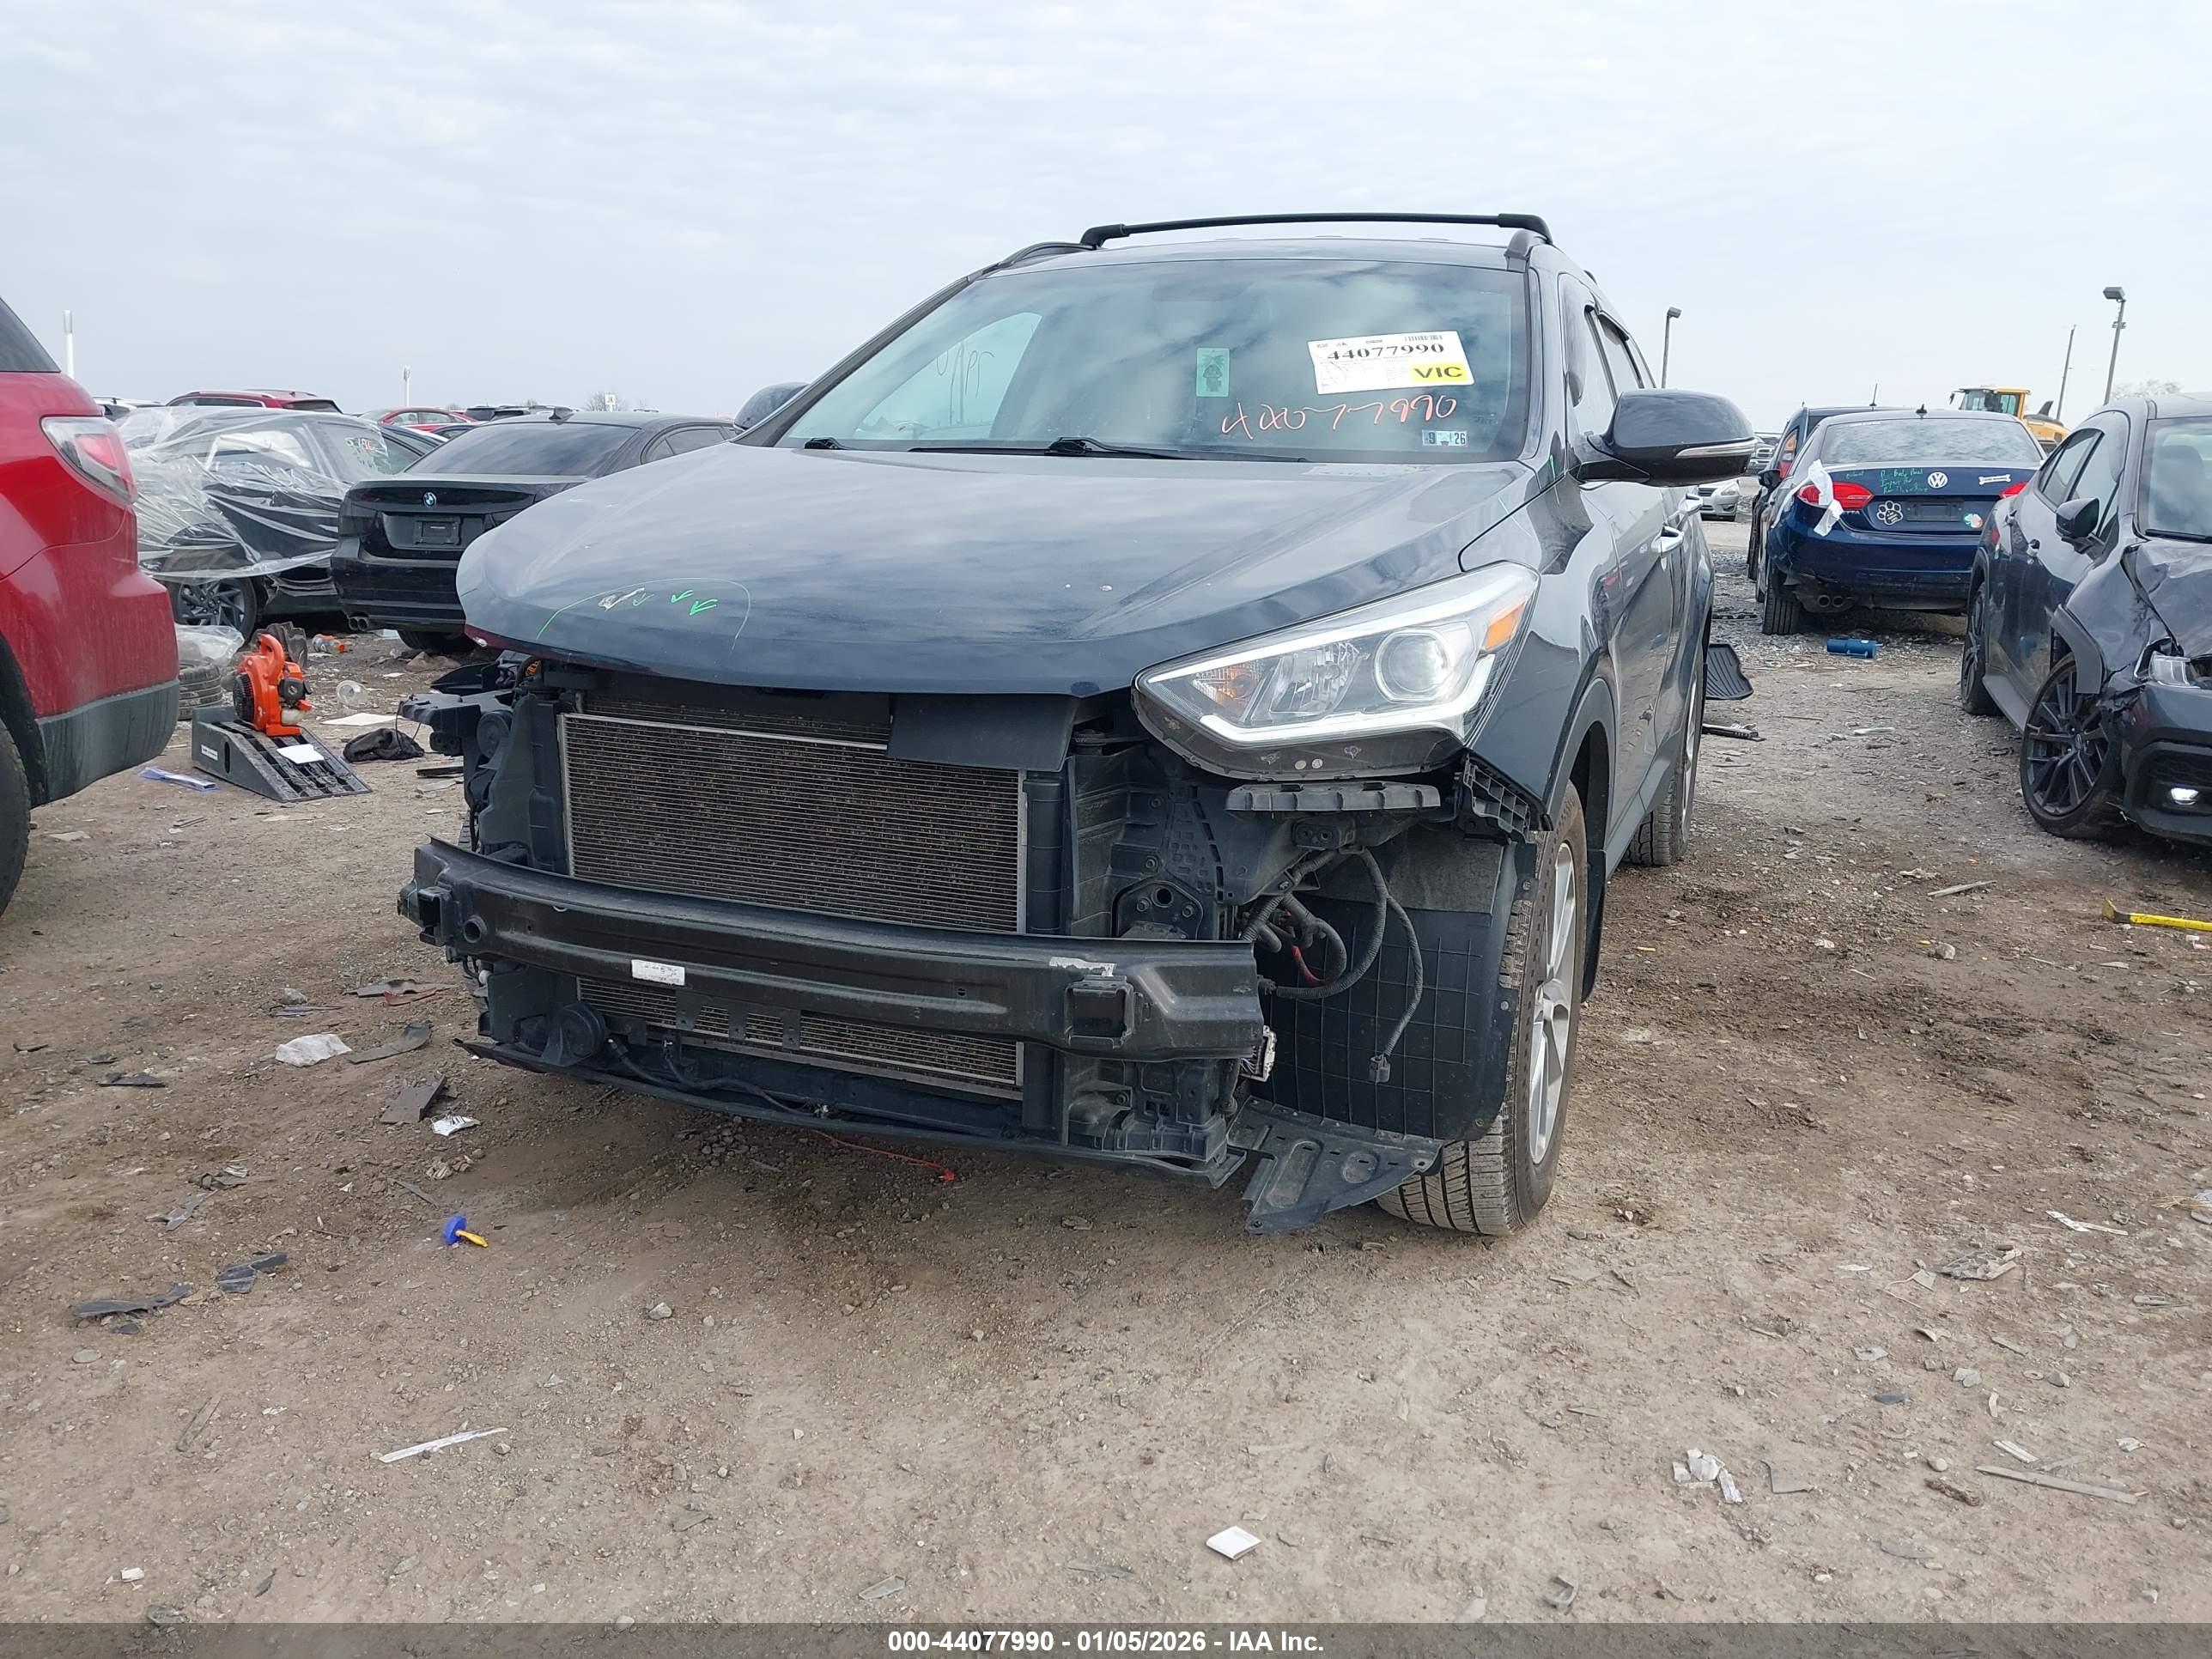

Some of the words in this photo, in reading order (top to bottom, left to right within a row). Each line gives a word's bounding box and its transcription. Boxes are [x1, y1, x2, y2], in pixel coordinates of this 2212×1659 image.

[1327, 343, 1444, 360] 44077990
[1413, 366, 1463, 379] VIC
[1454, 432, 1466, 445] 26
